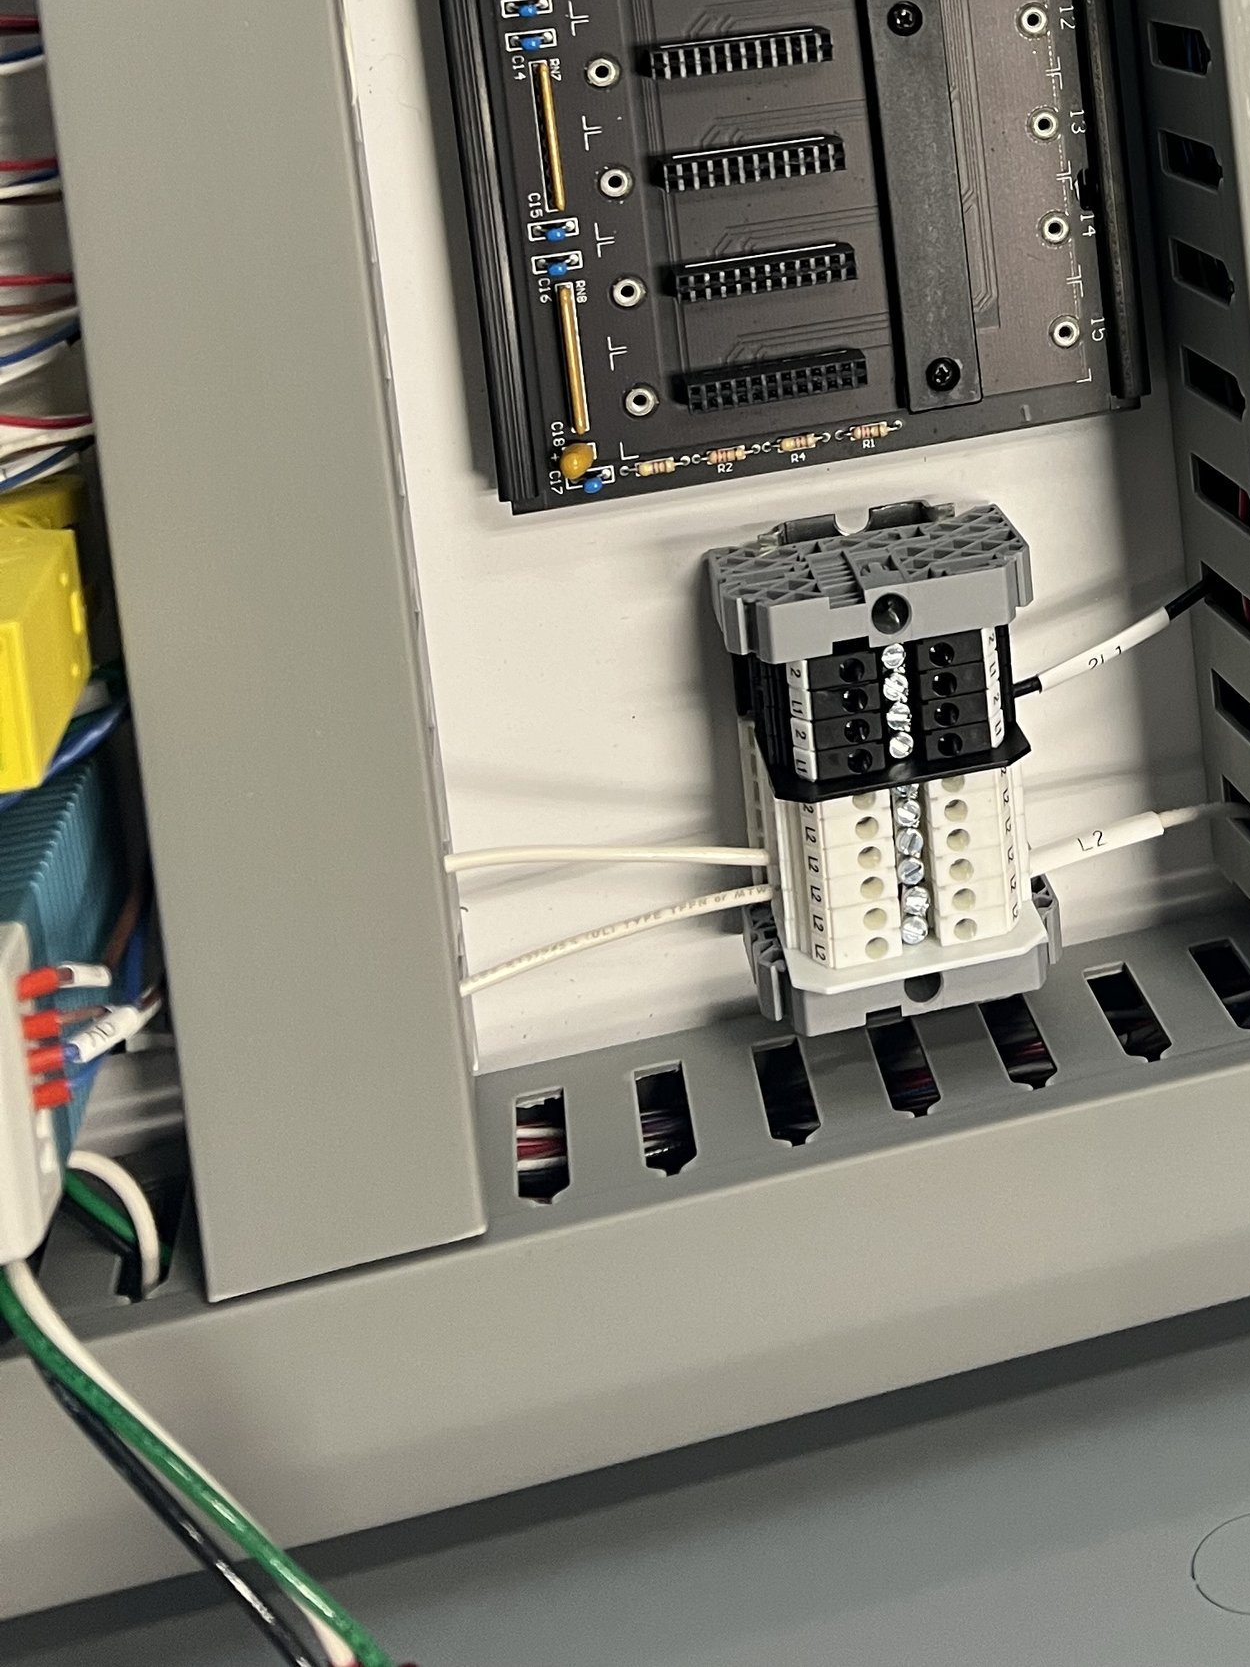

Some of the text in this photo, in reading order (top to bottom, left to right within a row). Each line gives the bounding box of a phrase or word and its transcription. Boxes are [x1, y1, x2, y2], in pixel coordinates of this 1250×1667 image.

[1059, 5, 1076, 30] 12
[512, 56, 526, 80] C14
[549, 57, 562, 81] RN7
[1070, 109, 1086, 134] 13
[528, 192, 543, 218] C15
[1080, 212, 1096, 237] 14
[538, 277, 551, 303] C16
[575, 280, 587, 303] RN8
[1091, 316, 1105, 342] 15
[551, 421, 565, 447] C18
[863, 439, 876, 449] R1
[717, 463, 733, 474] R2
[791, 452, 806, 463] R4
[549, 471, 563, 496] C17
[790, 667, 800, 679] 2
[795, 731, 806, 741] 2
[805, 826, 816, 843] L2
[1077, 831, 1106, 852] L2
[808, 856, 819, 873] L2
[810, 886, 821, 903] L2
[624, 912, 662, 928] TYPE
[734, 887, 767, 899] MTW
[813, 916, 824, 932] L2
[815, 944, 826, 961] L2
